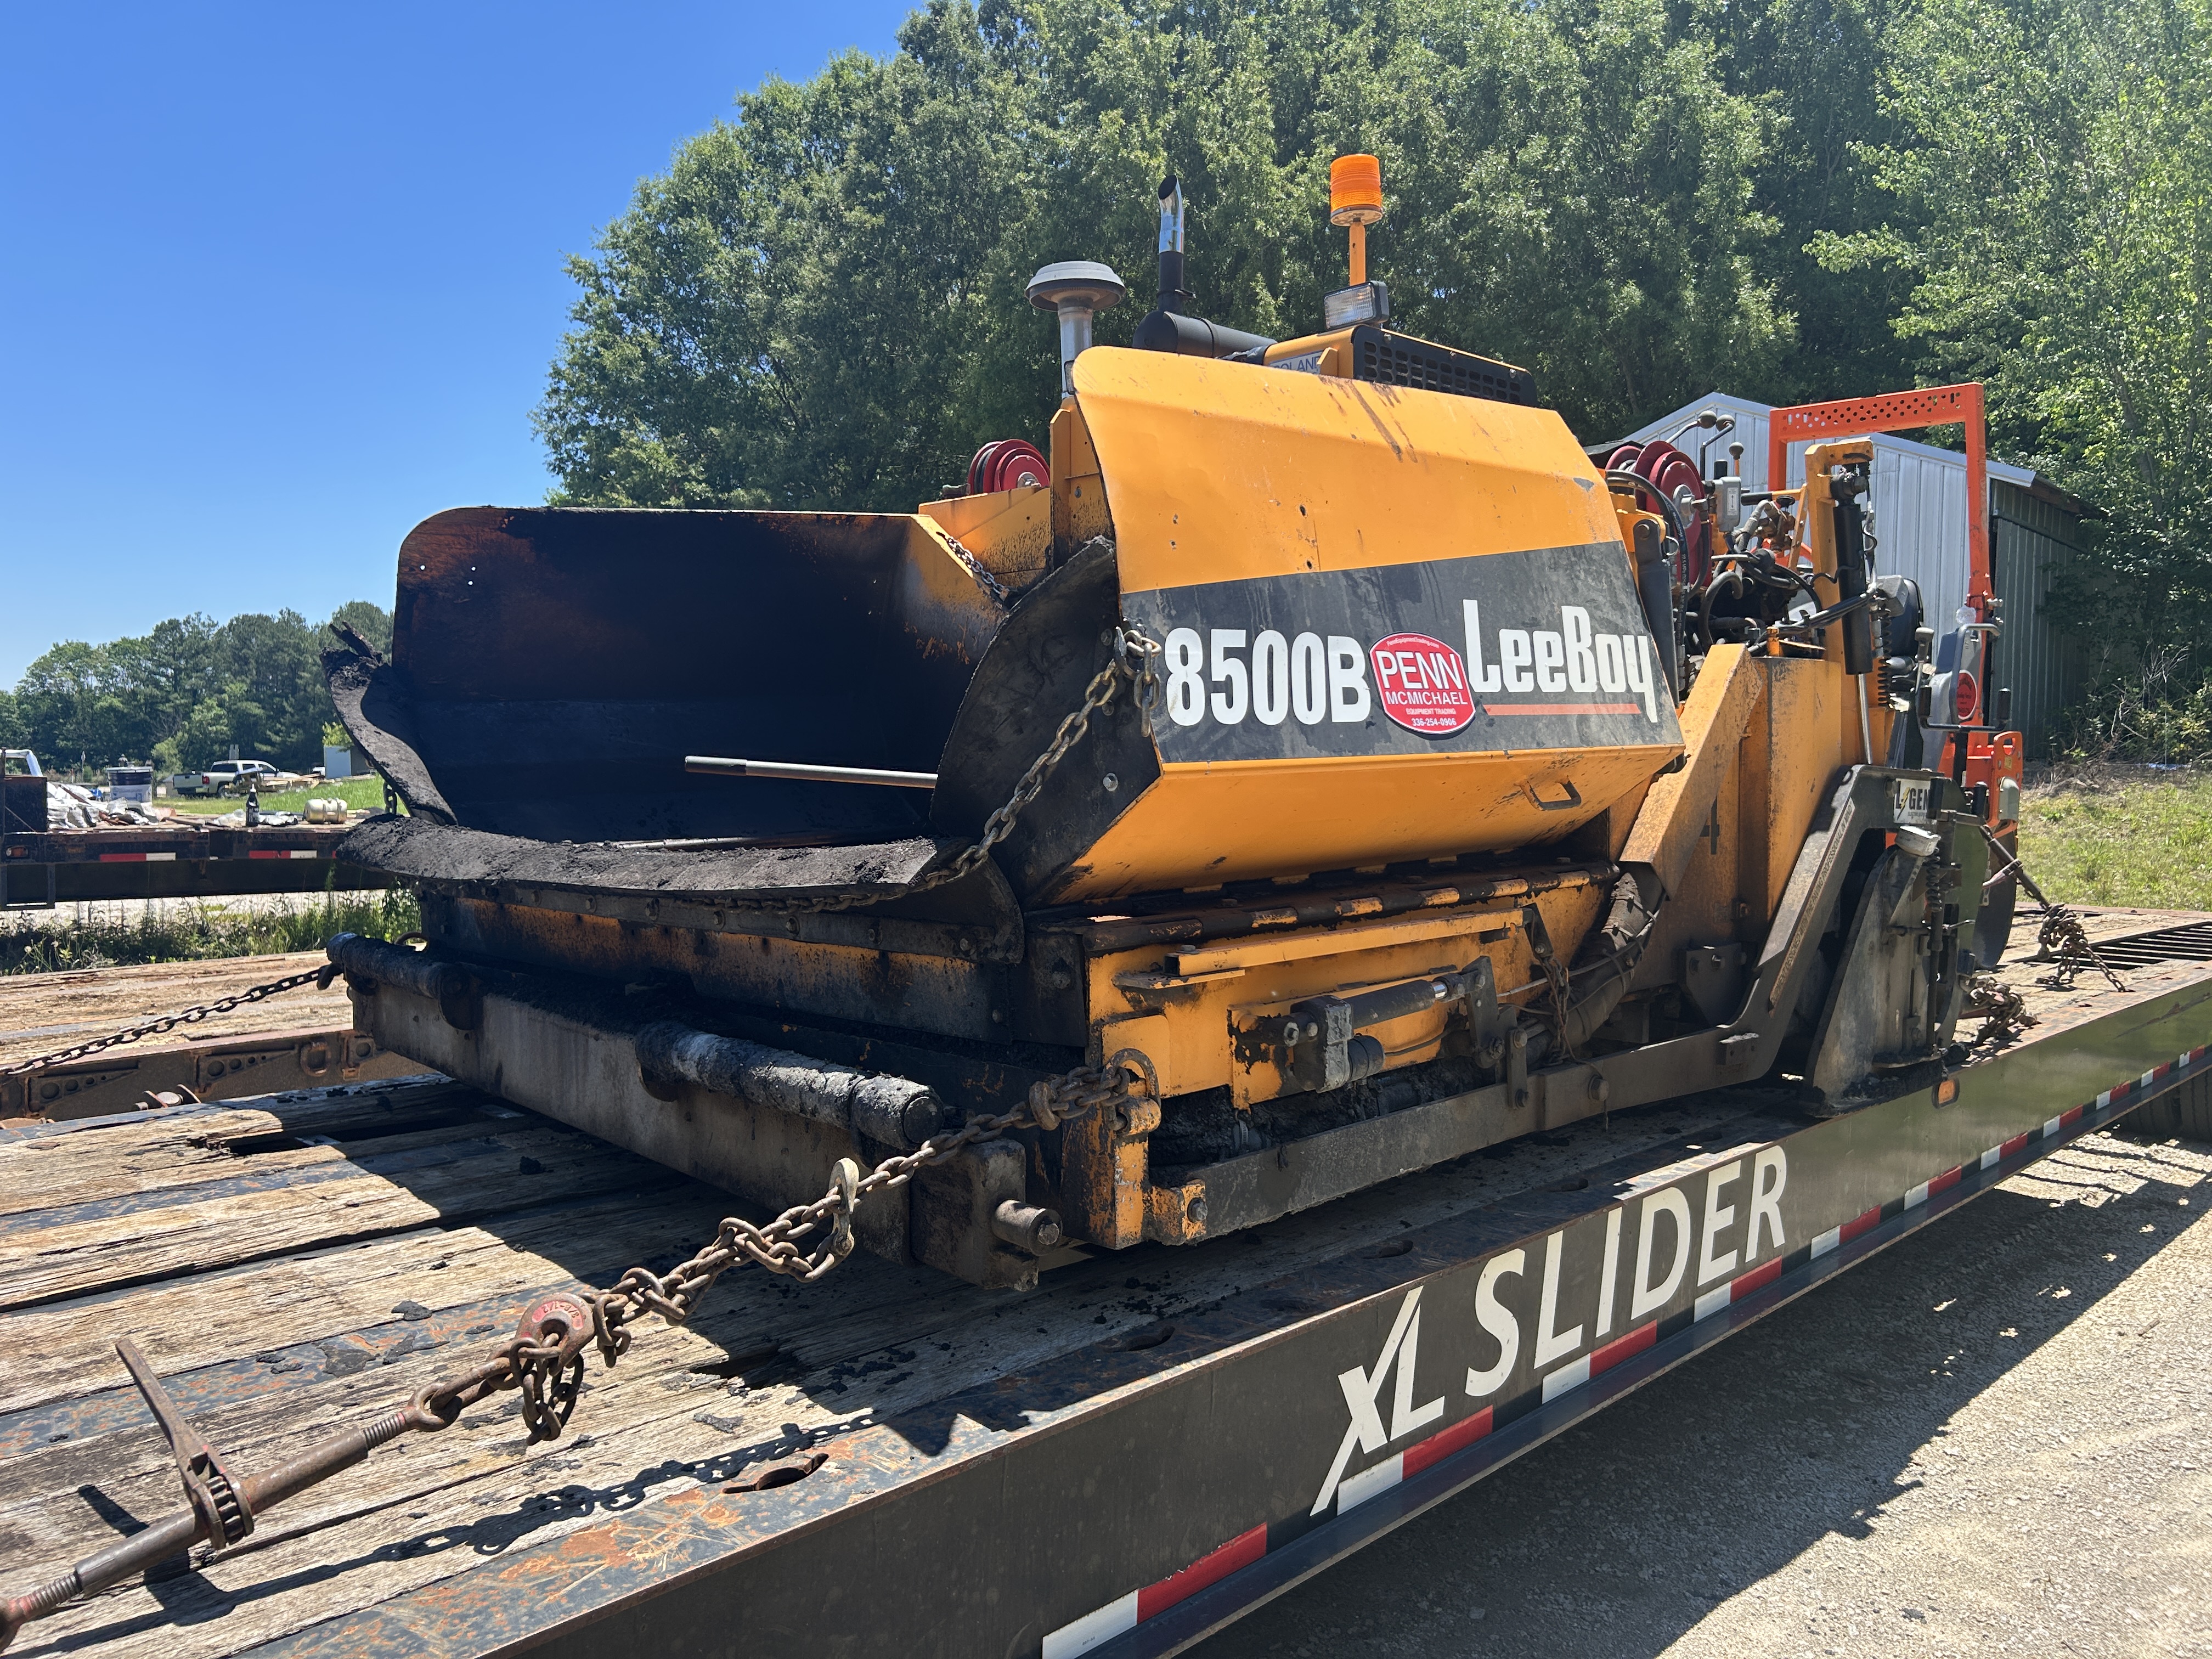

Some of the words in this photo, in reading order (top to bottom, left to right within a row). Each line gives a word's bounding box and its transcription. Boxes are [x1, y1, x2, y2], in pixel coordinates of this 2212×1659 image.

[1164, 628, 1370, 726] 8500B
[1375, 651, 1464, 690] PENN
[1463, 599, 1657, 723] LeeBoy
[1385, 691, 1468, 705] MCMICHAEL
[1411, 718, 1457, 726] 336-254-0906
[1465, 1145, 1787, 1397] SLIDER
